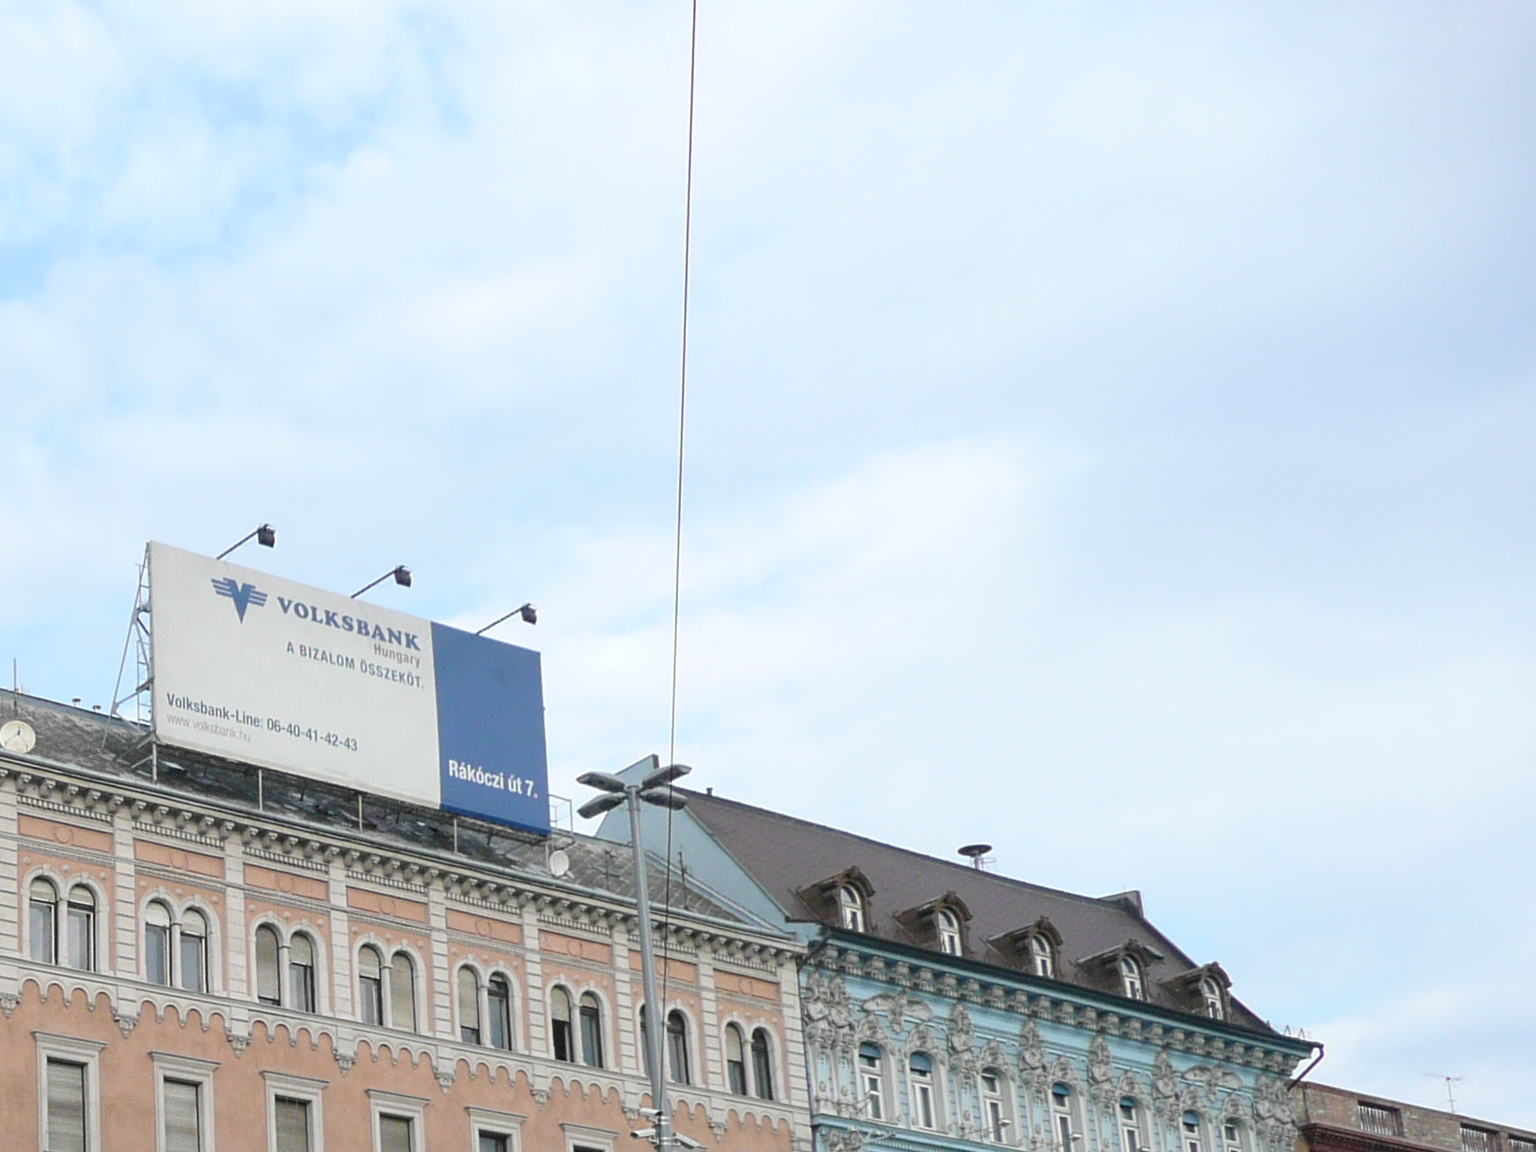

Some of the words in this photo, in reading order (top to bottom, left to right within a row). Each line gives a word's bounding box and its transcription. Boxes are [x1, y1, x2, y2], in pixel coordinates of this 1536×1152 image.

[277, 596, 421, 651] VOLKSBANK
[286, 641, 295, 655] A
[299, 644, 356, 670] BIZALOM
[360, 660, 424, 690] ÖSSZEKÖT.
[373, 642, 421, 669] Hungary
[166, 692, 264, 728] Volksbank-Line:
[266, 716, 358, 752] 06-40-41-42-43
[166, 714, 252, 743] www.volksbank.hu
[448, 759, 505, 790] Rákóczi
[508, 776, 523, 795] út
[524, 779, 539, 799] 7.
